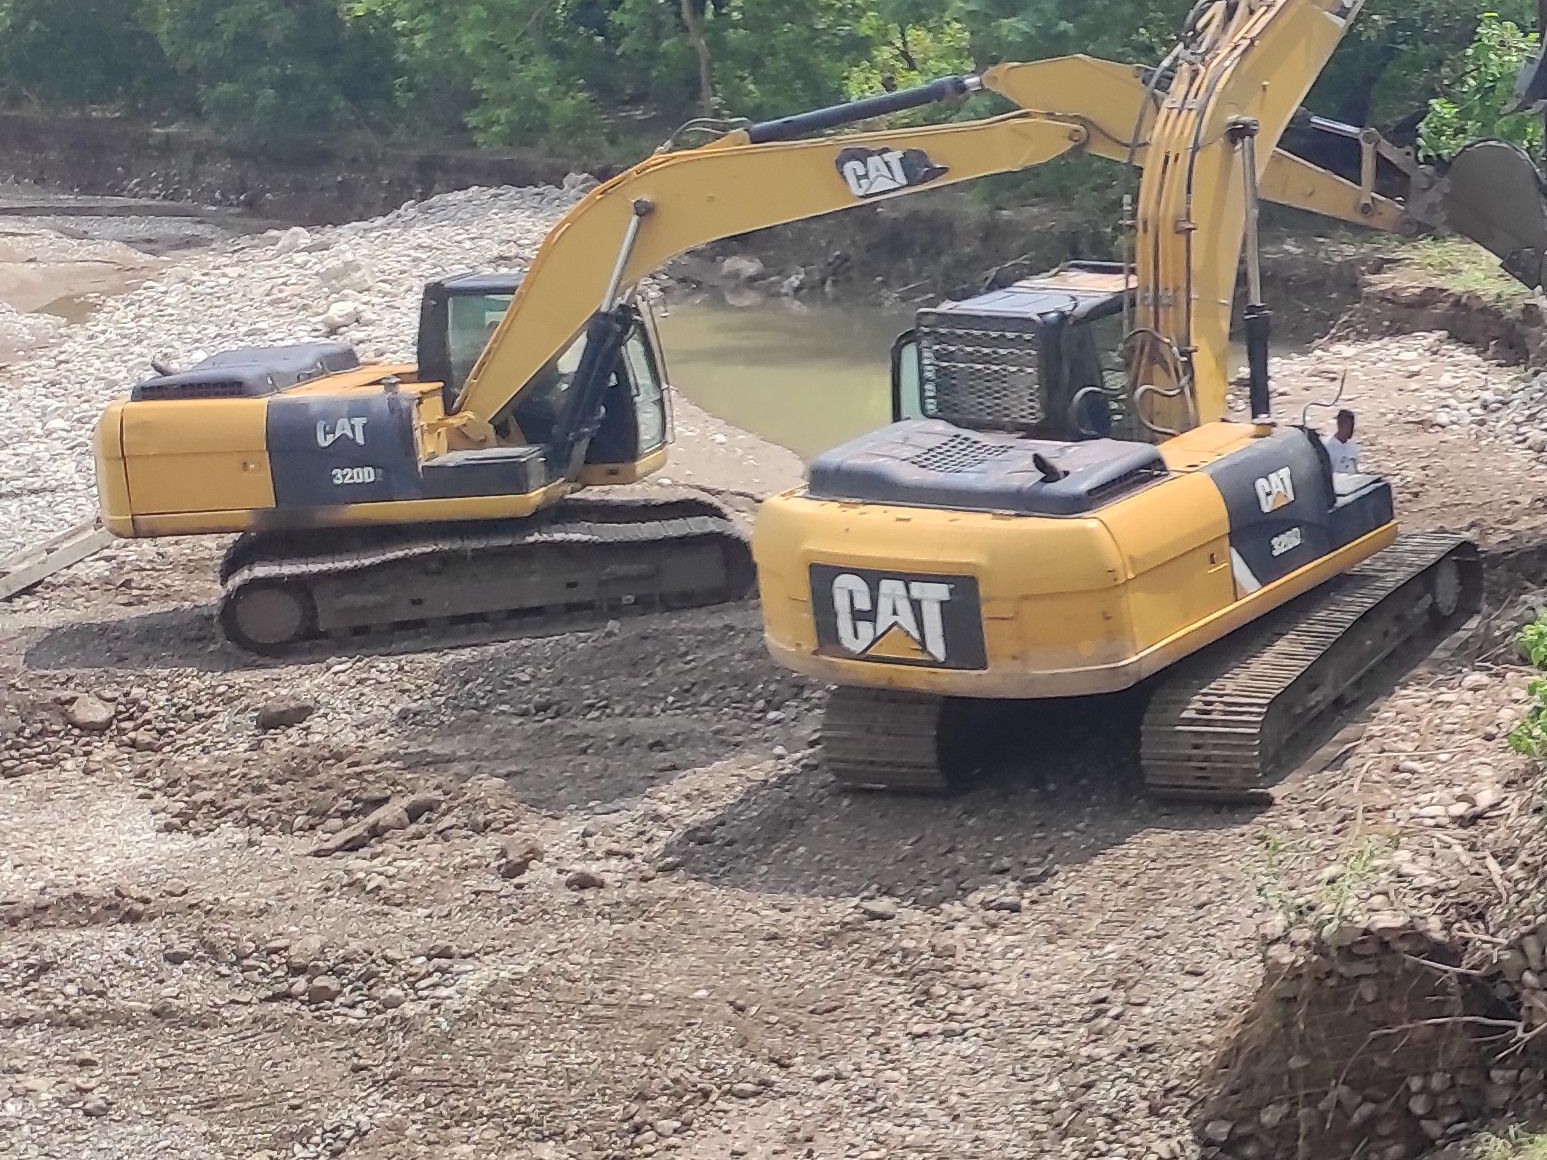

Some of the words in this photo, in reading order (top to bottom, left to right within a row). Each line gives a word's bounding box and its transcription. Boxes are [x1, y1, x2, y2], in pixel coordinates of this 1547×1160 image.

[843, 150, 908, 196] CAT
[316, 417, 368, 448] CAT
[1254, 466, 1295, 513] CAT
[832, 573, 951, 662] CAT
